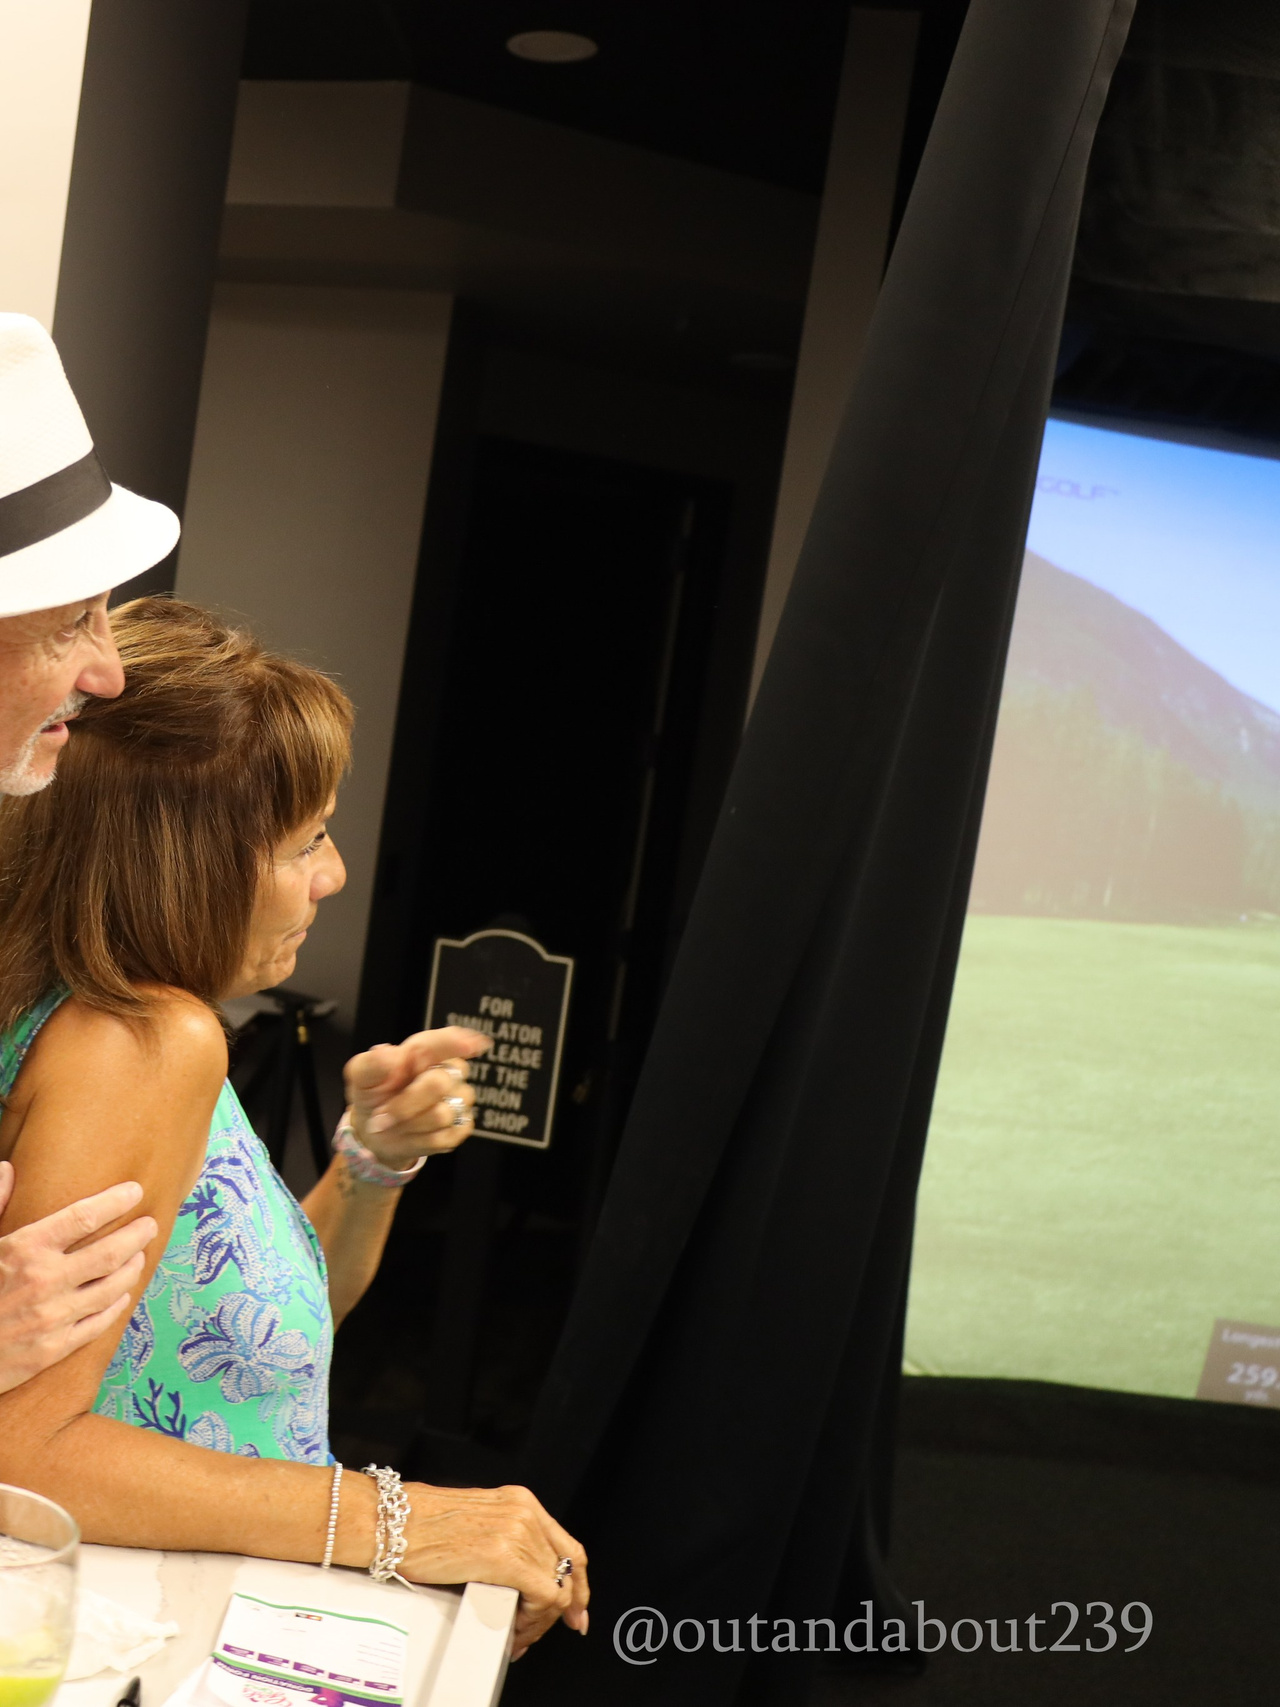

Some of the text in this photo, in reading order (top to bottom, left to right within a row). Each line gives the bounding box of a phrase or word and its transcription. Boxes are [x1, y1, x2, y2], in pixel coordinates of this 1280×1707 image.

[479, 995, 514, 1019] FOR
[477, 1043, 542, 1069] LEASE
[496, 1064, 529, 1089] THE
[483, 1108, 529, 1133] SHOP
